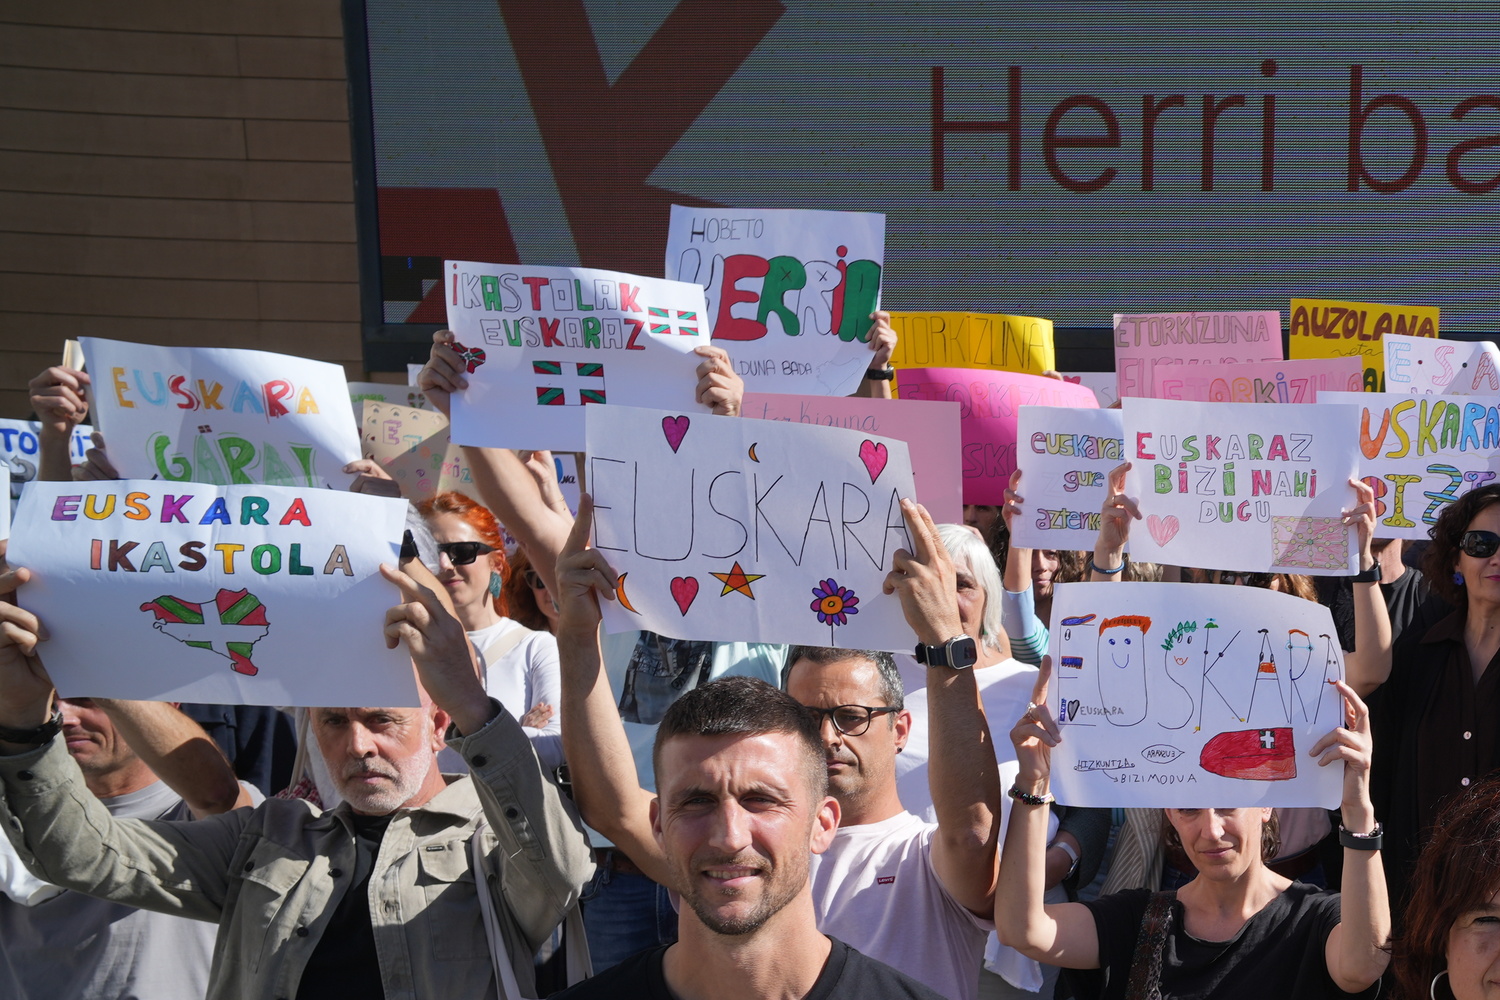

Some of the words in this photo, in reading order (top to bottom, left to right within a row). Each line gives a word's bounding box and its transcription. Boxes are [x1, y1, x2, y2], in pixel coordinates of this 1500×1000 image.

[931, 58, 1277, 192] Herri
[690, 217, 765, 243] HOBETO
[481, 318, 646, 350] EUSKARAZ
[1290, 305, 1436, 341] AUZOLANA
[782, 361, 813, 376] BADA
[110, 366, 321, 423] EUSKARA
[1136, 431, 1313, 462] EUSKARAZ
[1063, 470, 1105, 492] gure
[51, 490, 312, 528] EUSKARA
[592, 457, 916, 571] EUSKARA
[1199, 500, 1270, 523] DUGU
[90, 540, 355, 577] IKASTOLA
[1080, 706, 1124, 716] EUSKARA
[1077, 758, 1132, 770] HIZKUNTZA
